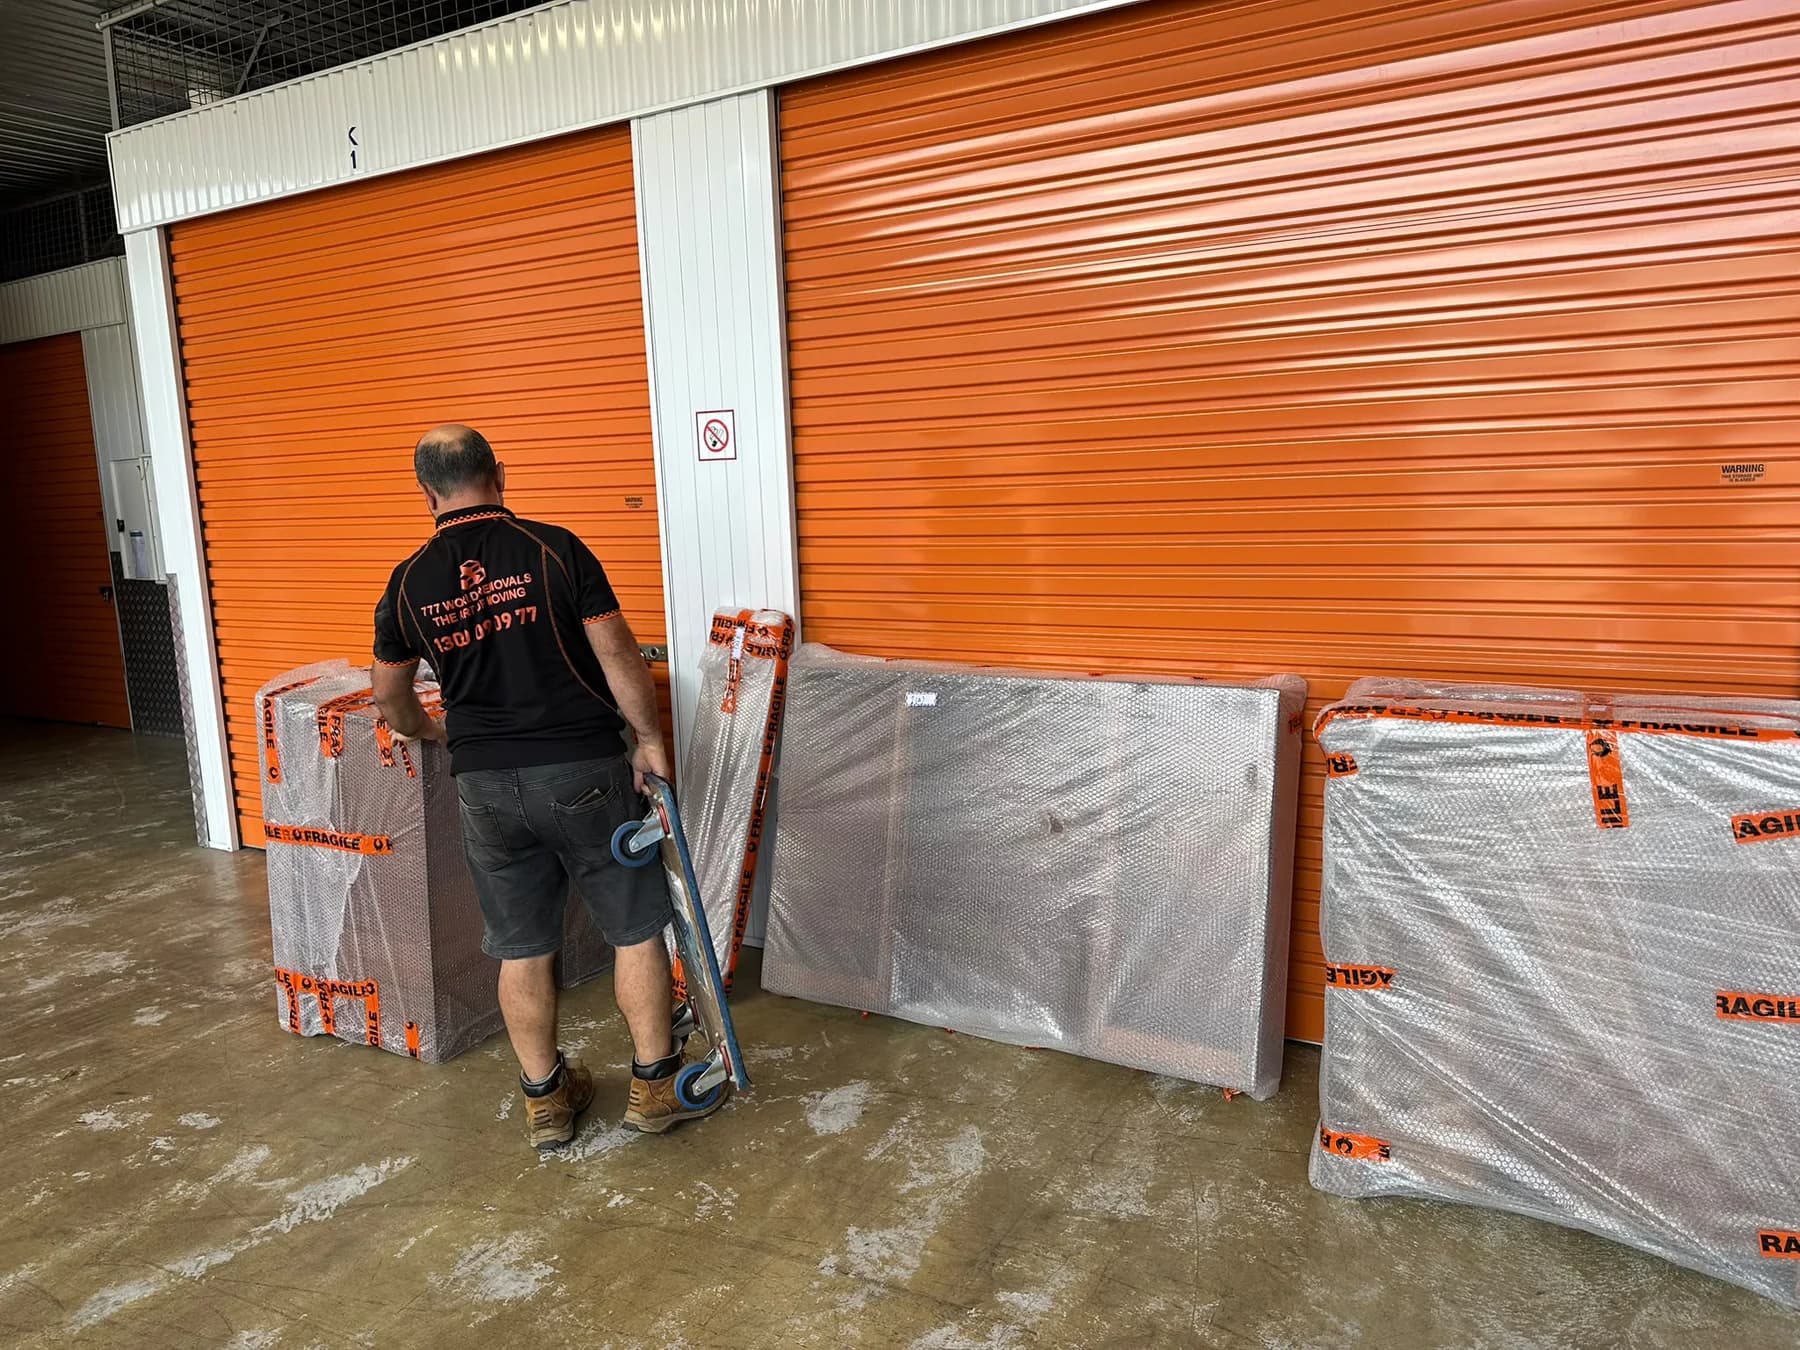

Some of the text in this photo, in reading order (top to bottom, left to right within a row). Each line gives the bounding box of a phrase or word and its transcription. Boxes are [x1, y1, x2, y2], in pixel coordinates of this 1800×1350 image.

[1721, 463, 1765, 473] WARNING
[420, 603, 440, 617] 777
[514, 606, 538, 625] 77
[432, 612, 458, 628] THE
[768, 676, 785, 743] FRAGILE
[304, 831, 361, 851] FRAGILE
[735, 870, 753, 938] FRAGILE
